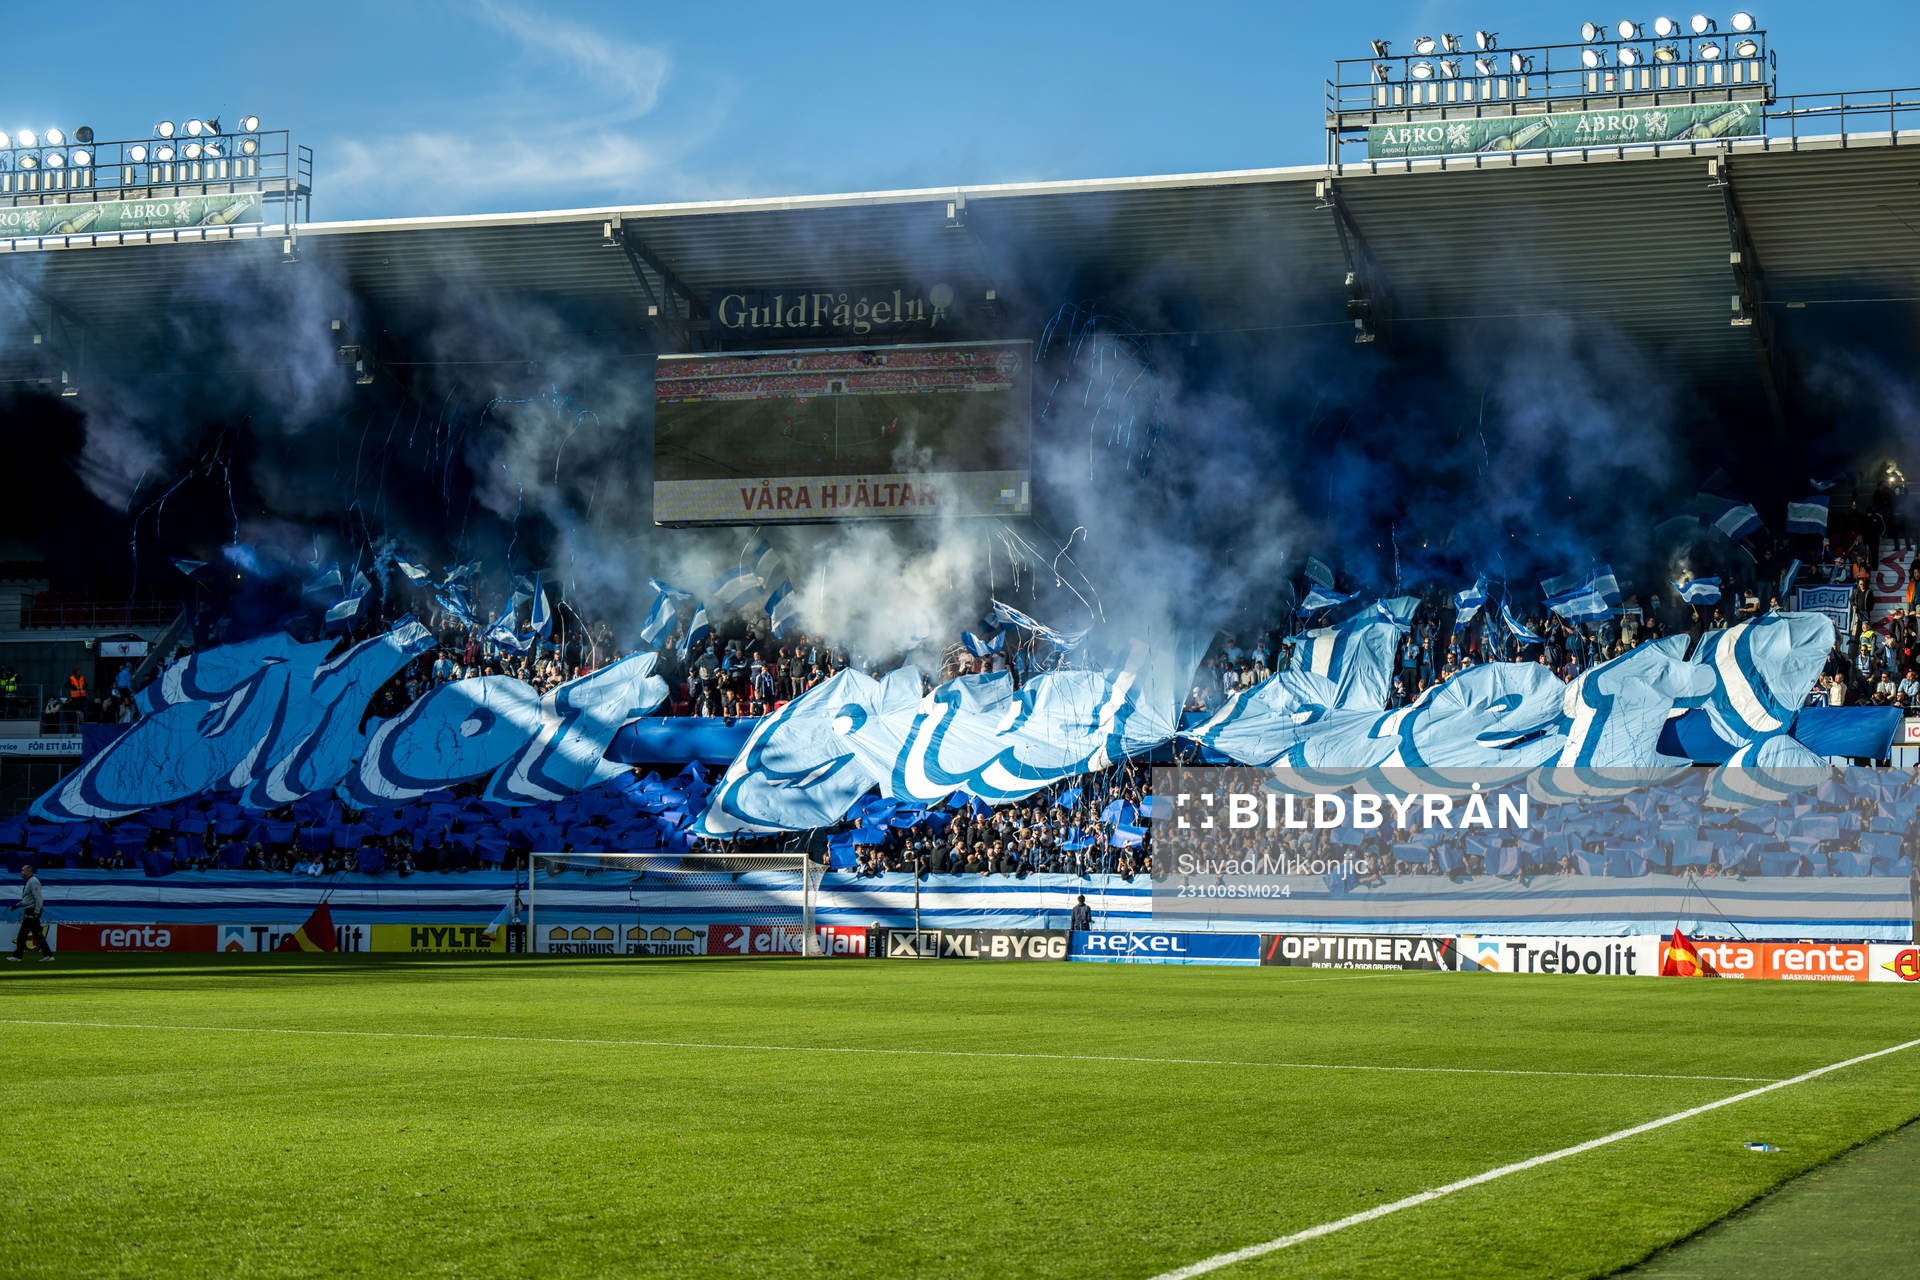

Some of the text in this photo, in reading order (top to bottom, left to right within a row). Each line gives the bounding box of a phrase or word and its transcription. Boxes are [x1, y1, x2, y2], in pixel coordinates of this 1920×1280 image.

[1575, 114, 1639, 133] ÅBRO
[1382, 127, 1444, 145] ÅBRO
[120, 202, 169, 219] ÅBRO
[718, 289, 926, 334] GuldFågeln
[740, 479, 812, 511] VÅRA
[1805, 592, 1846, 606] HEJA
[100, 926, 171, 948] renta
[411, 927, 491, 947] HYLTE
[944, 934, 1067, 958] XL-BYGG
[1282, 937, 1434, 962] OPTIMERA
[1506, 942, 1637, 976] Trebolit
[1664, 944, 1754, 970] nta
[1772, 945, 1864, 971] renta
